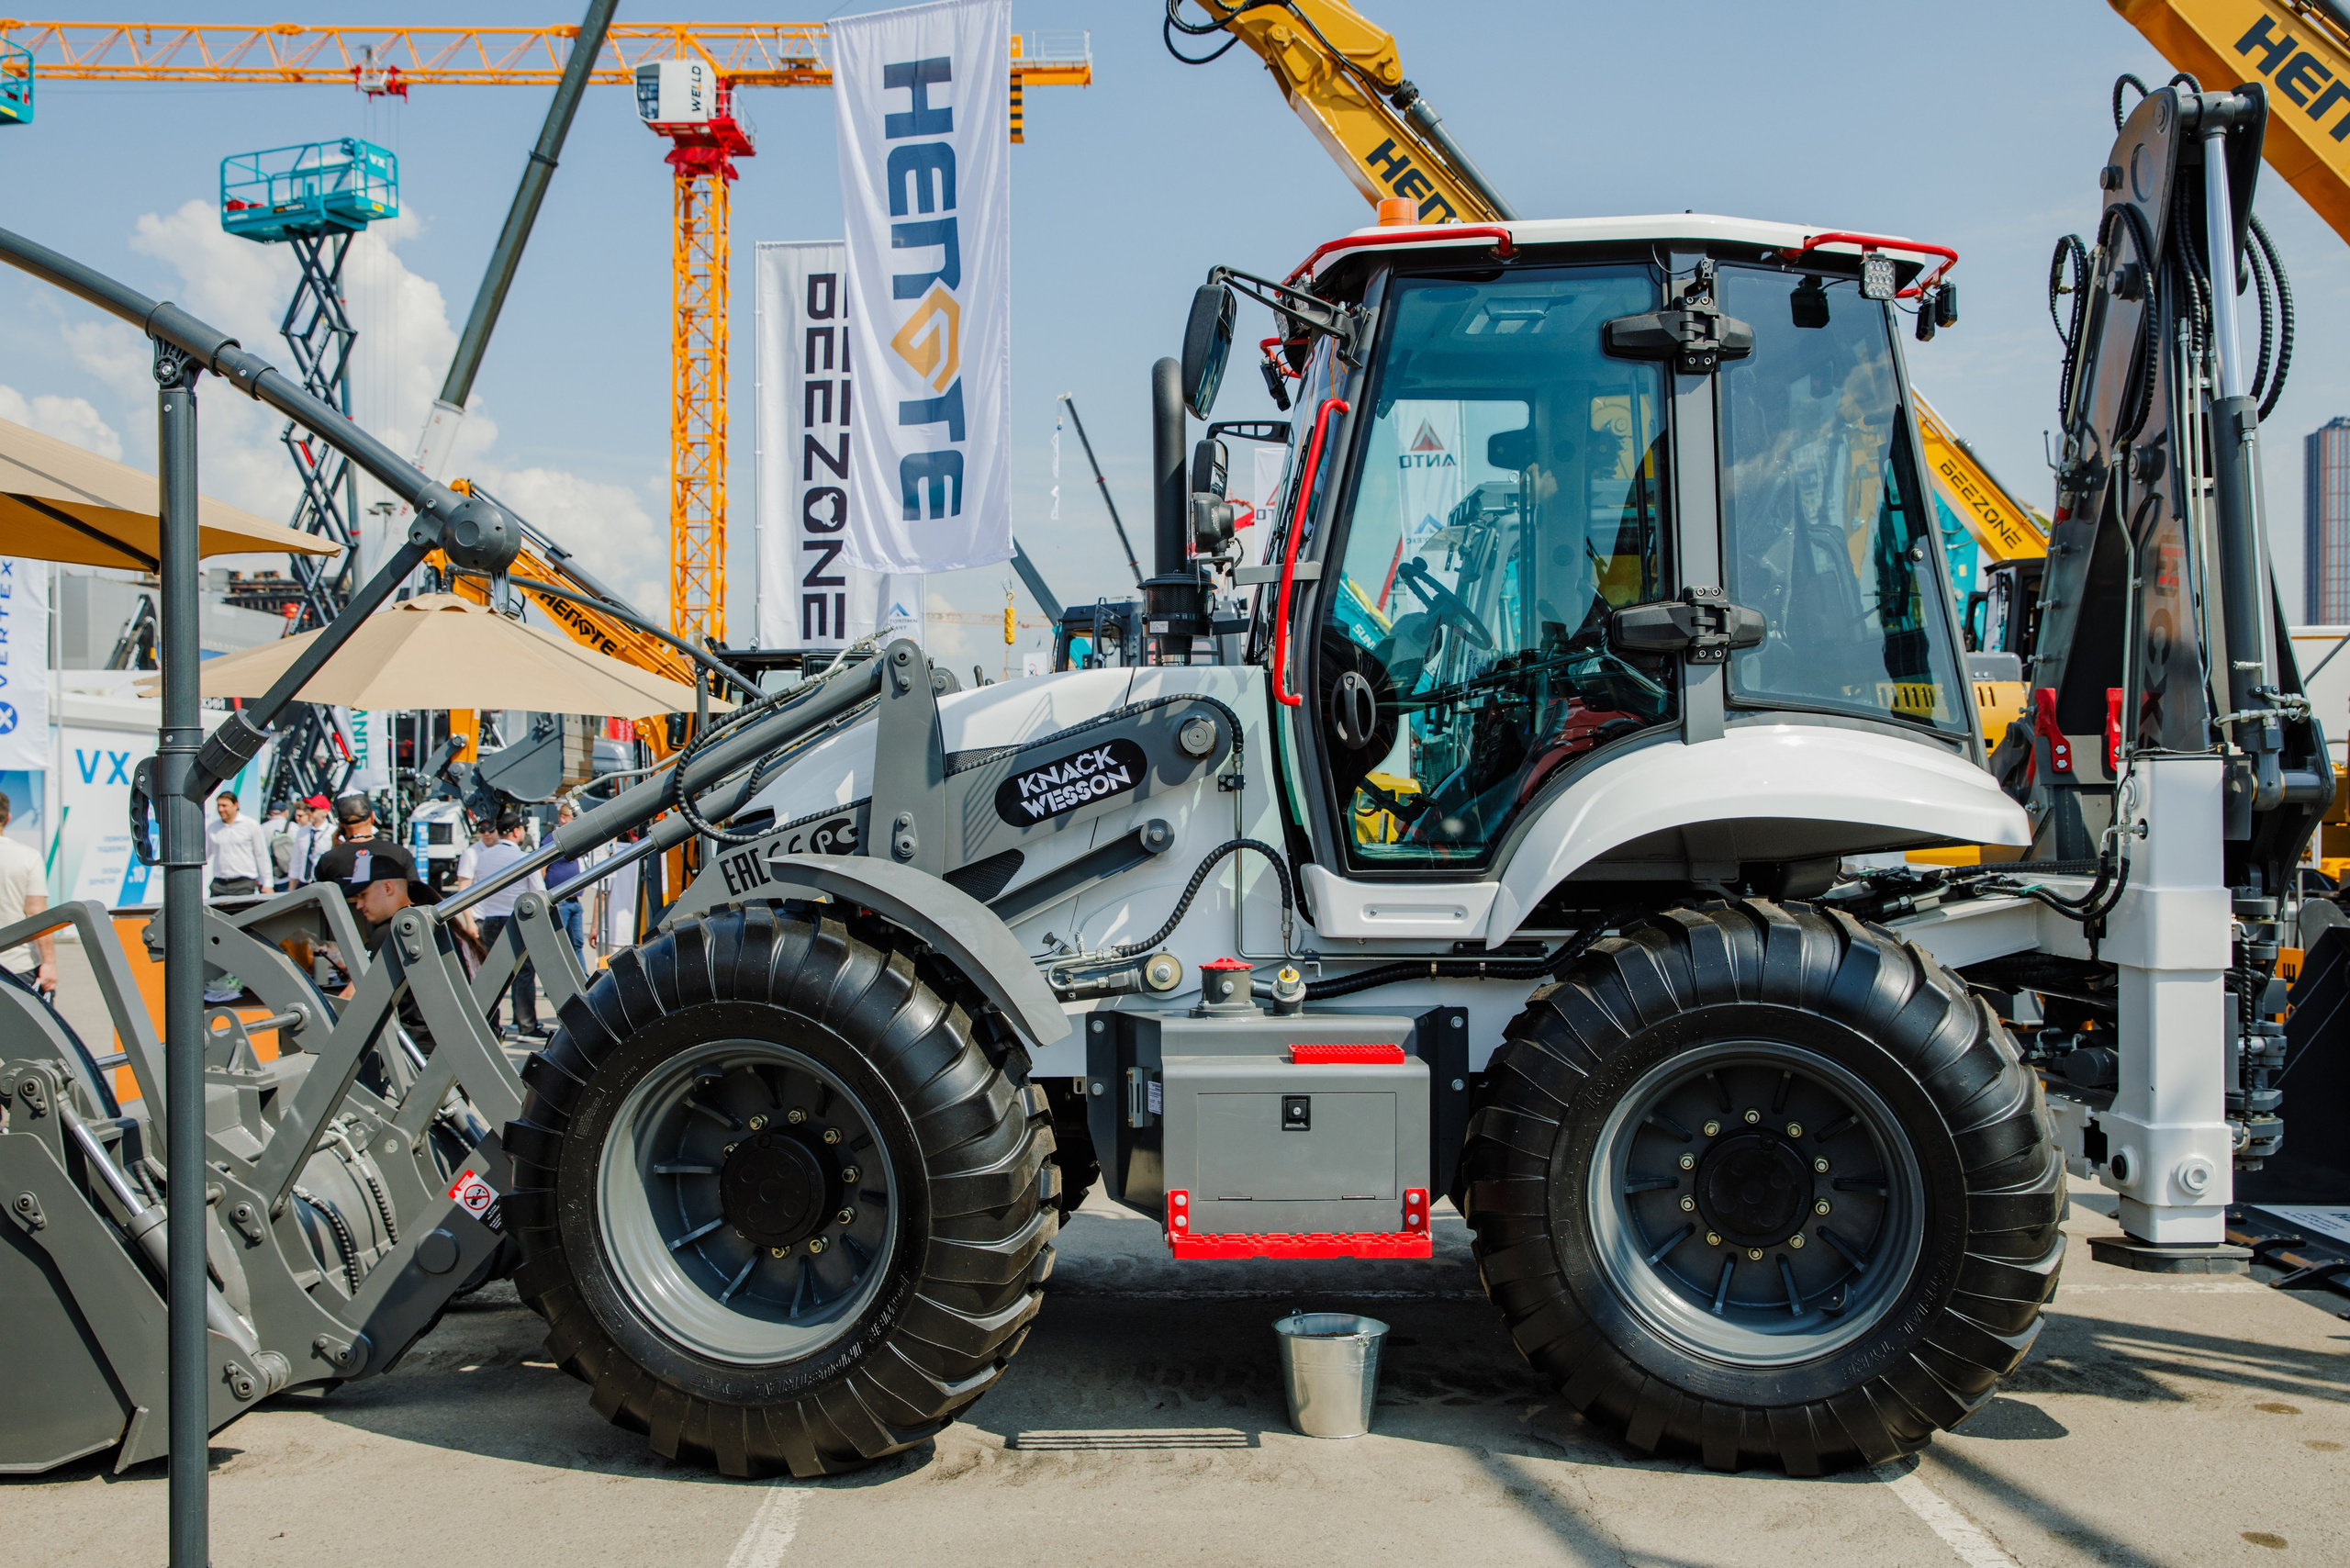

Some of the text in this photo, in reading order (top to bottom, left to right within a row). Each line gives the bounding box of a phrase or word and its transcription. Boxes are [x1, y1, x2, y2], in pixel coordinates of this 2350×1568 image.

[1940, 459, 2022, 549] BEEZONE
[1018, 745, 1118, 798] KNACK
[1021, 765, 1132, 819] WESSON
